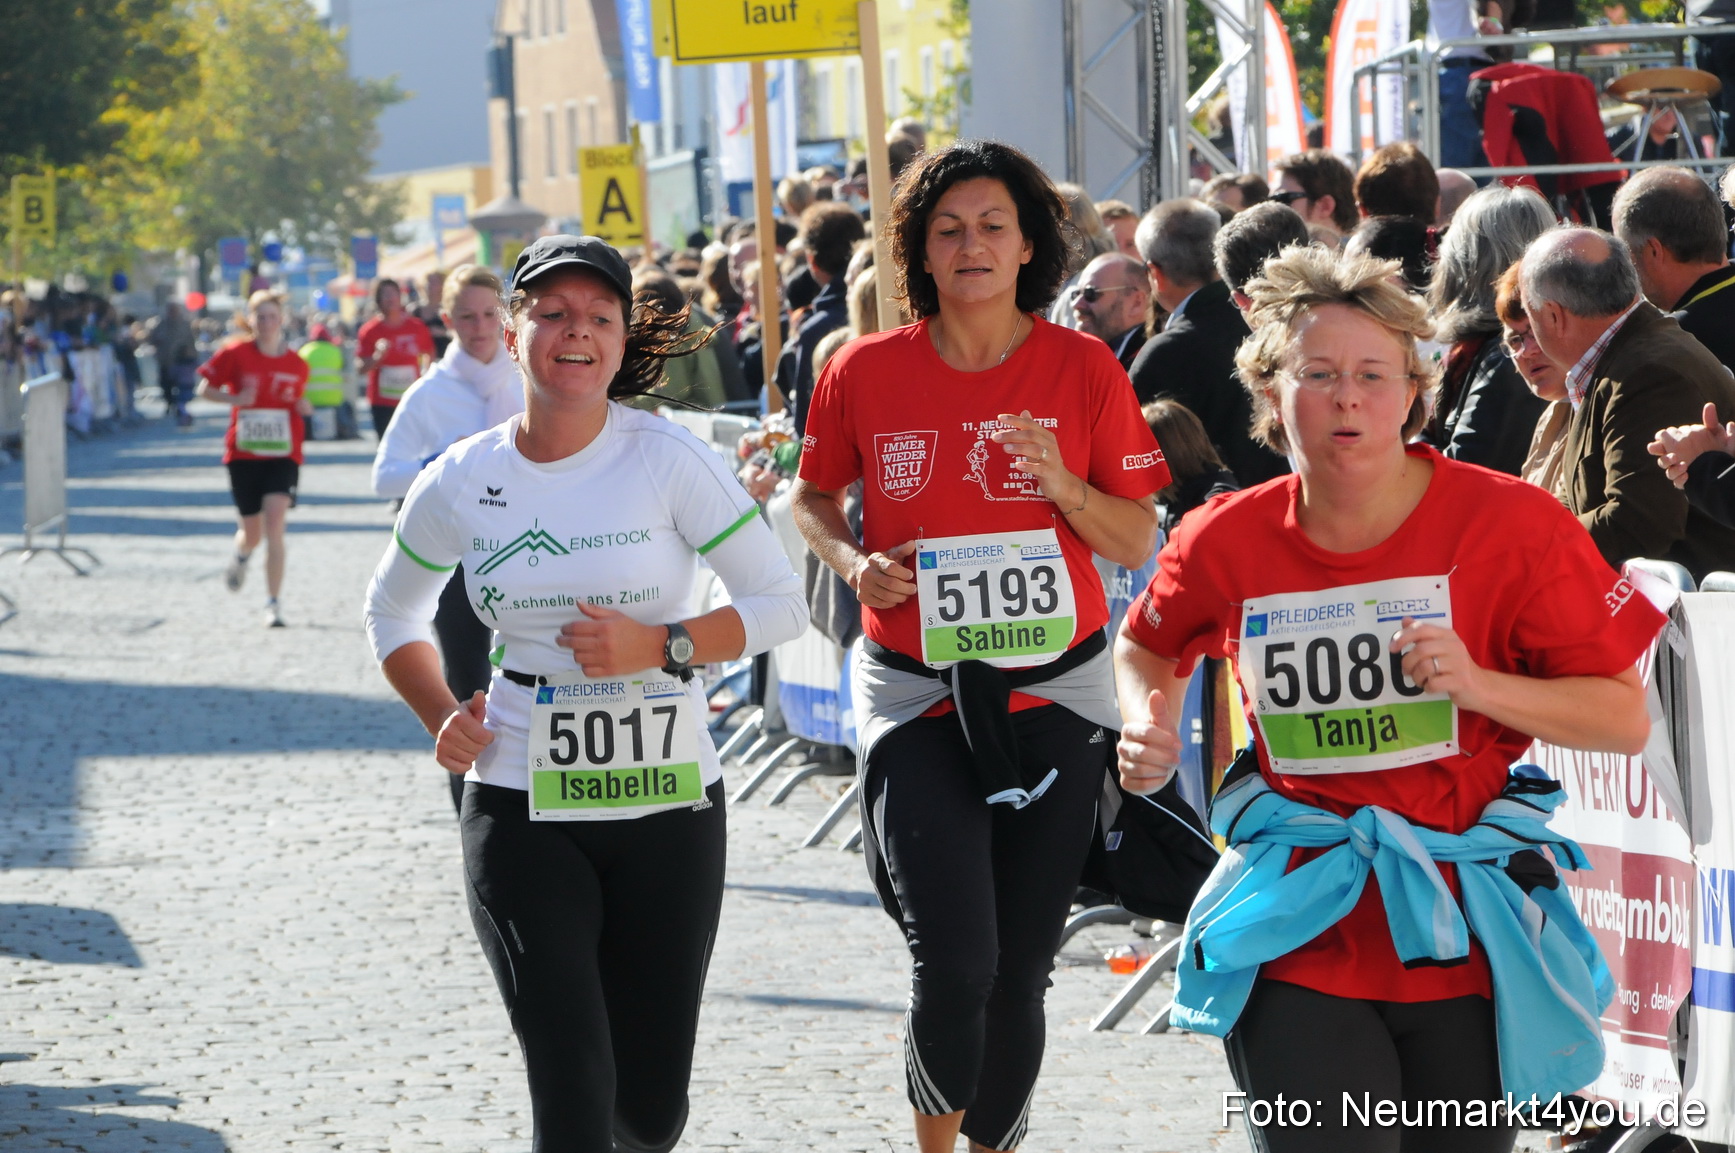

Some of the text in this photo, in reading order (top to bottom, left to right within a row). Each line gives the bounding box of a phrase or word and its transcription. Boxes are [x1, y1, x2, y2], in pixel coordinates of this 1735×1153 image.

[744, 0, 799, 25] lauf
[24, 195, 44, 225] B
[598, 177, 632, 225] A
[962, 422, 978, 431] 11.
[883, 439, 926, 453] IMMER
[881, 450, 927, 464] WIEDER
[1122, 449, 1166, 471] BOCK
[884, 461, 922, 480] NEU
[884, 476, 922, 491] MARKT
[479, 498, 507, 508] erima
[939, 544, 1060, 562] PFLEIDERER BOCK
[940, 558, 1006, 569] AKTIENGESELLSCHAFT
[587, 594, 613, 606] ans
[619, 586, 660, 604] Ziel!!!
[937, 565, 1059, 622] 5193
[1270, 599, 1430, 626] PFLEIDERER BOCK
[1270, 619, 1356, 636] AKTIENGESELLSCHAFT
[956, 623, 1046, 652] Sabine
[556, 682, 625, 697] PFLEIDERER
[555, 697, 627, 705] AKTIENGESELLSCHAFT
[549, 704, 678, 766] 5017
[1304, 709, 1399, 752] Tanja
[560, 768, 677, 801] Isabella
